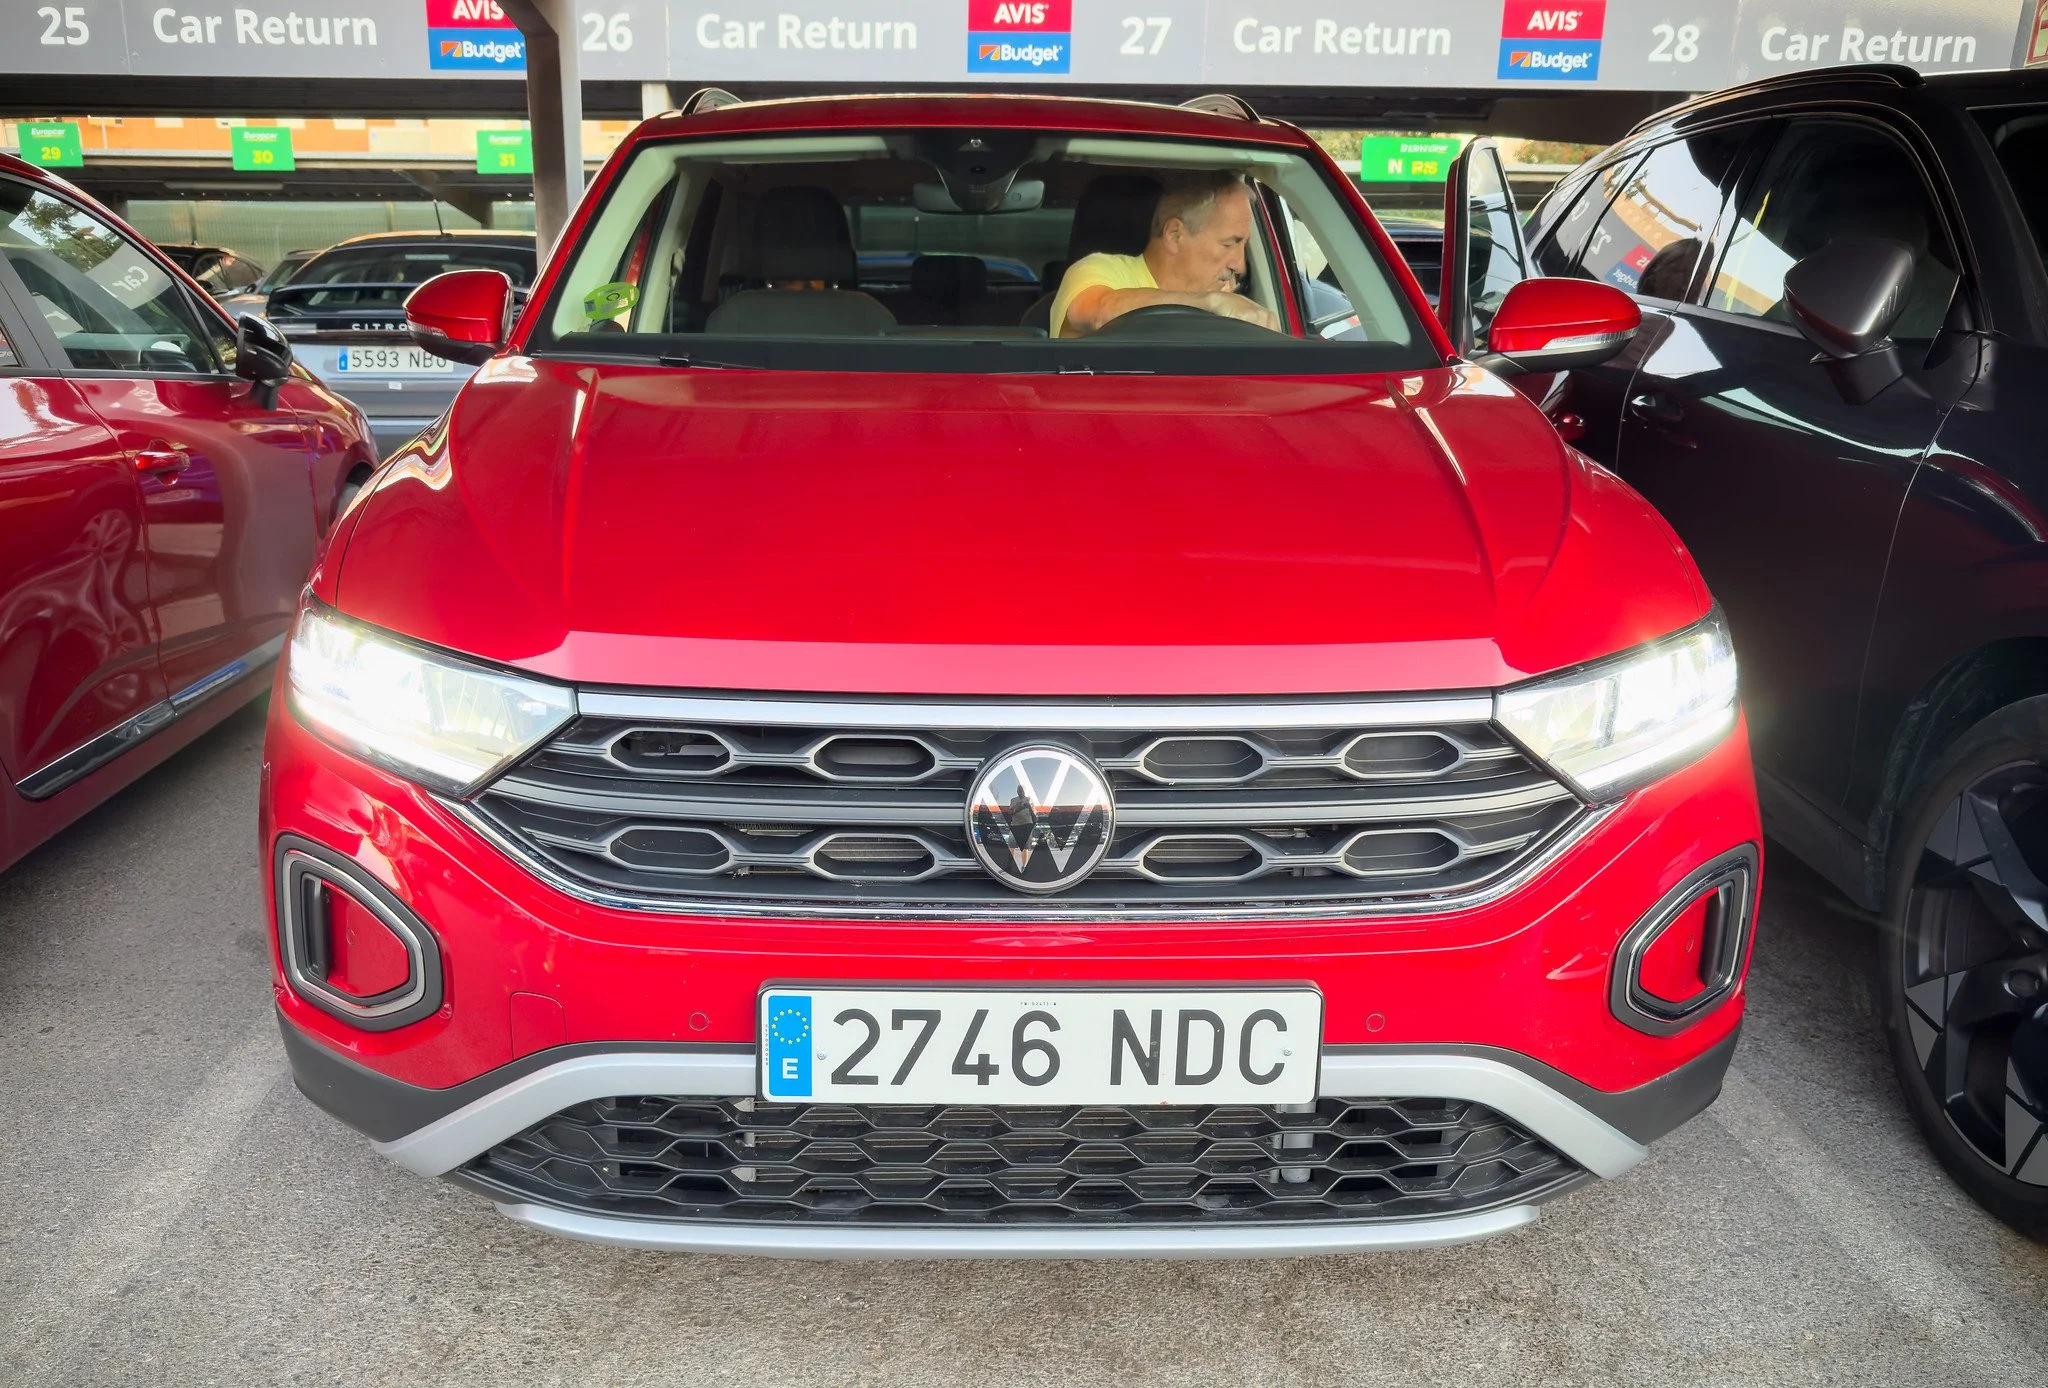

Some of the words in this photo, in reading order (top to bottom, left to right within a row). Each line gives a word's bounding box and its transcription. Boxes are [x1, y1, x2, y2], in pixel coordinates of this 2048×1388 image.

[453, 0, 504, 20] AVIS
[994, 4, 1046, 24] AVIS
[1527, 10, 1579, 31] AVIS
[39, 8, 90, 45] 25
[152, 8, 222, 45] Car
[237, 9, 378, 46] Return
[582, 12, 633, 52] 26
[696, 13, 767, 49] Car
[778, 13, 917, 49] Return
[1120, 17, 1172, 54] 27
[1233, 17, 1301, 54] Car
[1314, 19, 1451, 55] Return
[461, 40, 523, 63] Budget
[1648, 24, 1700, 62] 28
[1761, 27, 1828, 62] Car
[1840, 27, 1976, 63] Return
[1001, 44, 1061, 66] Budget
[1531, 51, 1591, 72] Budget
[41, 147, 62, 160] 29
[252, 150, 273, 164] 30
[499, 153, 515, 167] 31
[352, 350, 399, 368] 5593
[830, 1008, 1061, 1087] 2746
[1109, 1008, 1289, 1086] NDC
[782, 1057, 799, 1079] E
